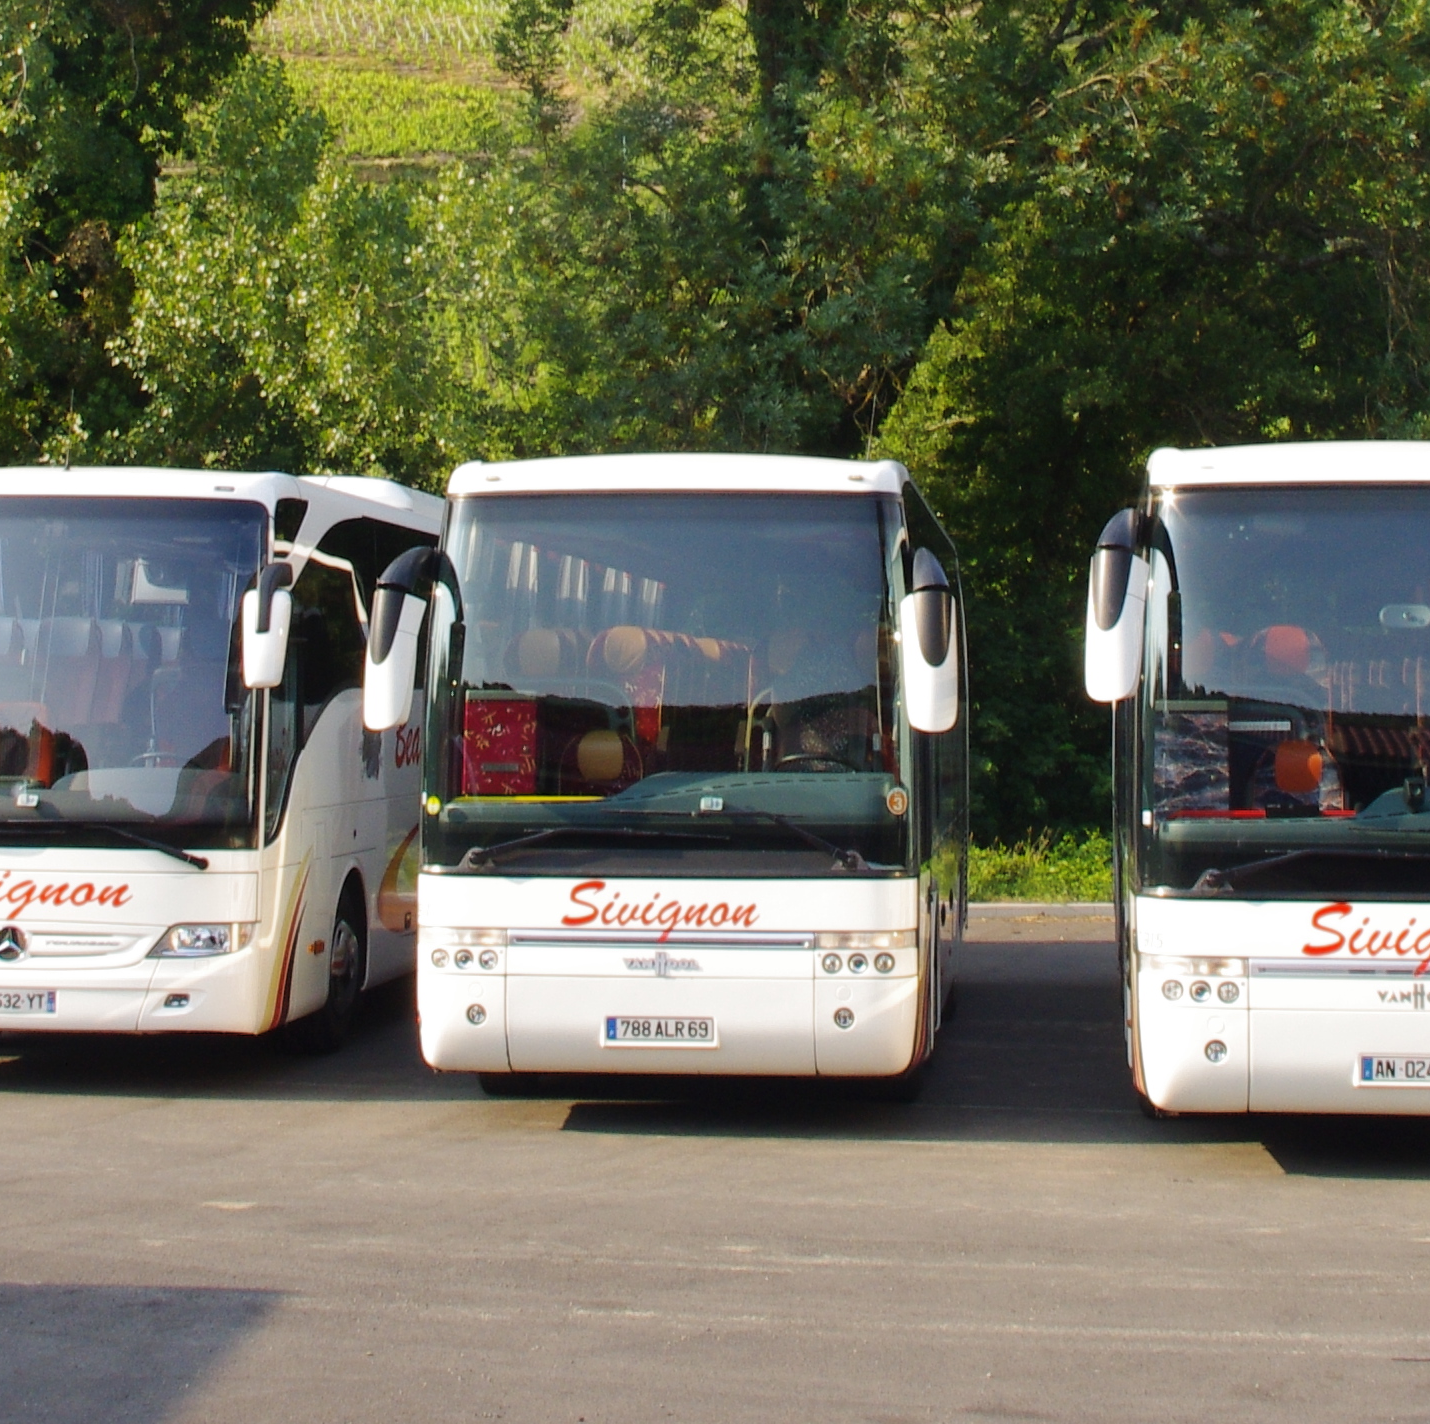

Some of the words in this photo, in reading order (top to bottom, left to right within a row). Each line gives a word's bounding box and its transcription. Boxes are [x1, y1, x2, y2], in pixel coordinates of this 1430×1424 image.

[561, 880, 760, 943] Sivignon
[621, 1020, 651, 1038] 788
[654, 1020, 685, 1039] ALR
[688, 1021, 709, 1039] 69
